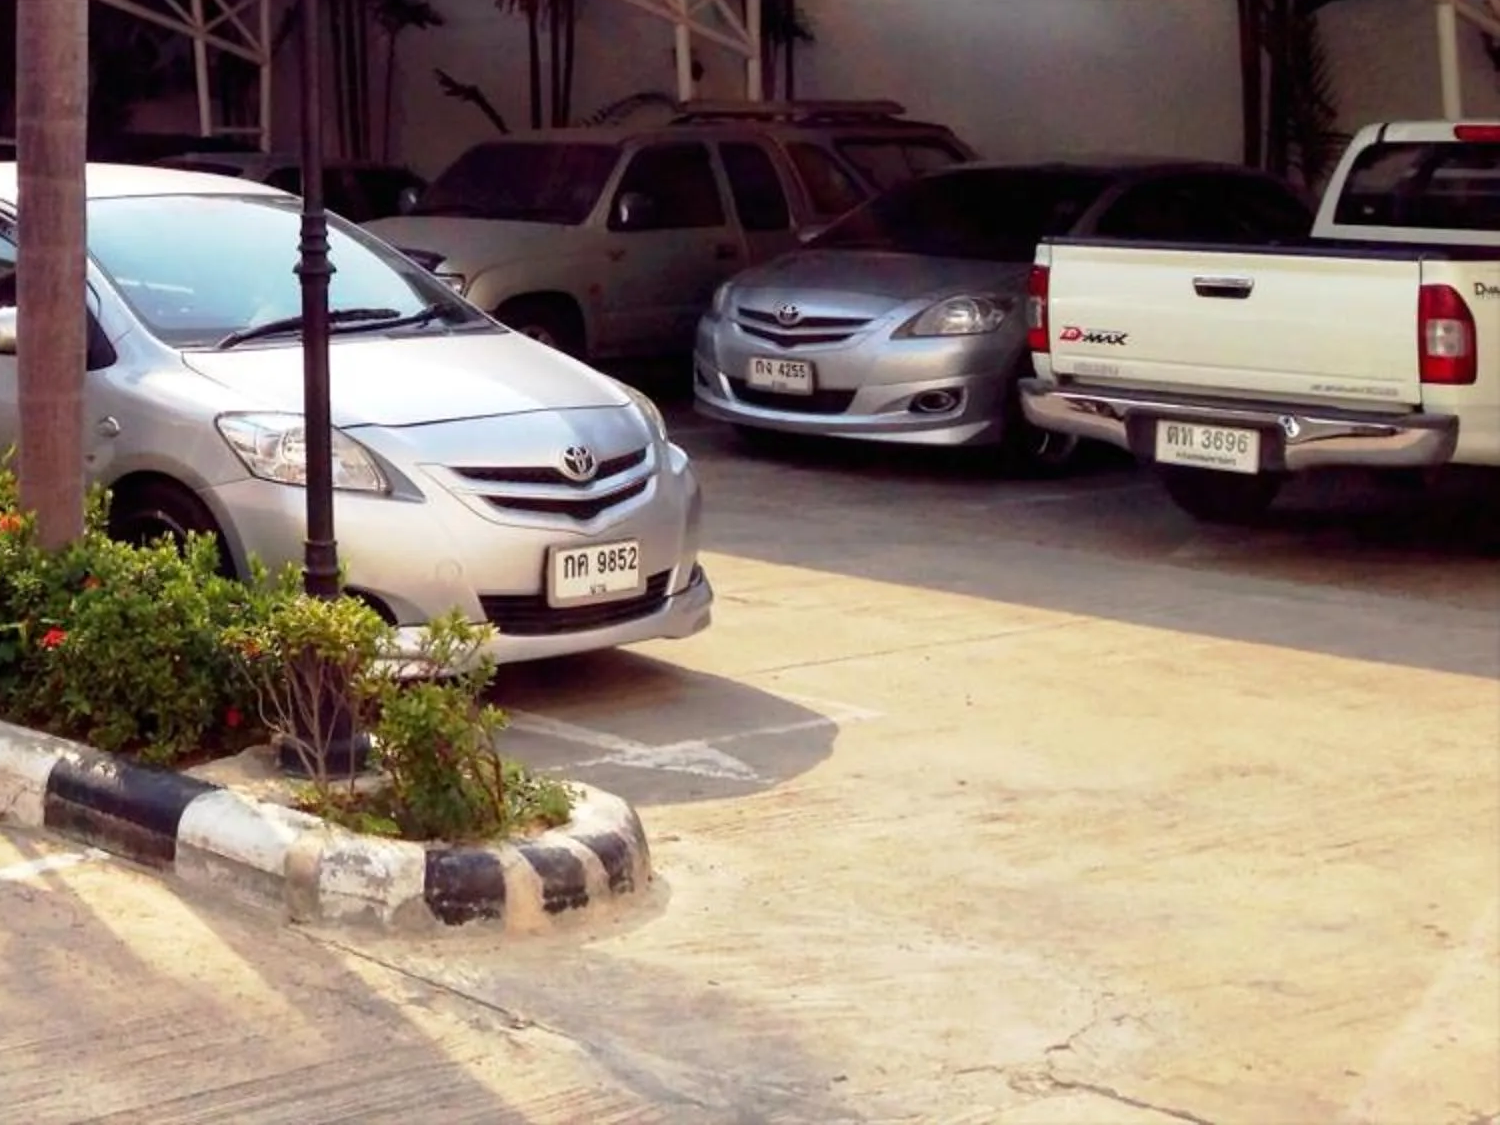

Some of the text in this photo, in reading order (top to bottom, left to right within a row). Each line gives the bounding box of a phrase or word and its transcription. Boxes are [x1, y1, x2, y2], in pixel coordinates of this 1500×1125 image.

[779, 362, 805, 379] 4255
[1201, 428, 1249, 454] 3696
[597, 546, 637, 573] 9852
